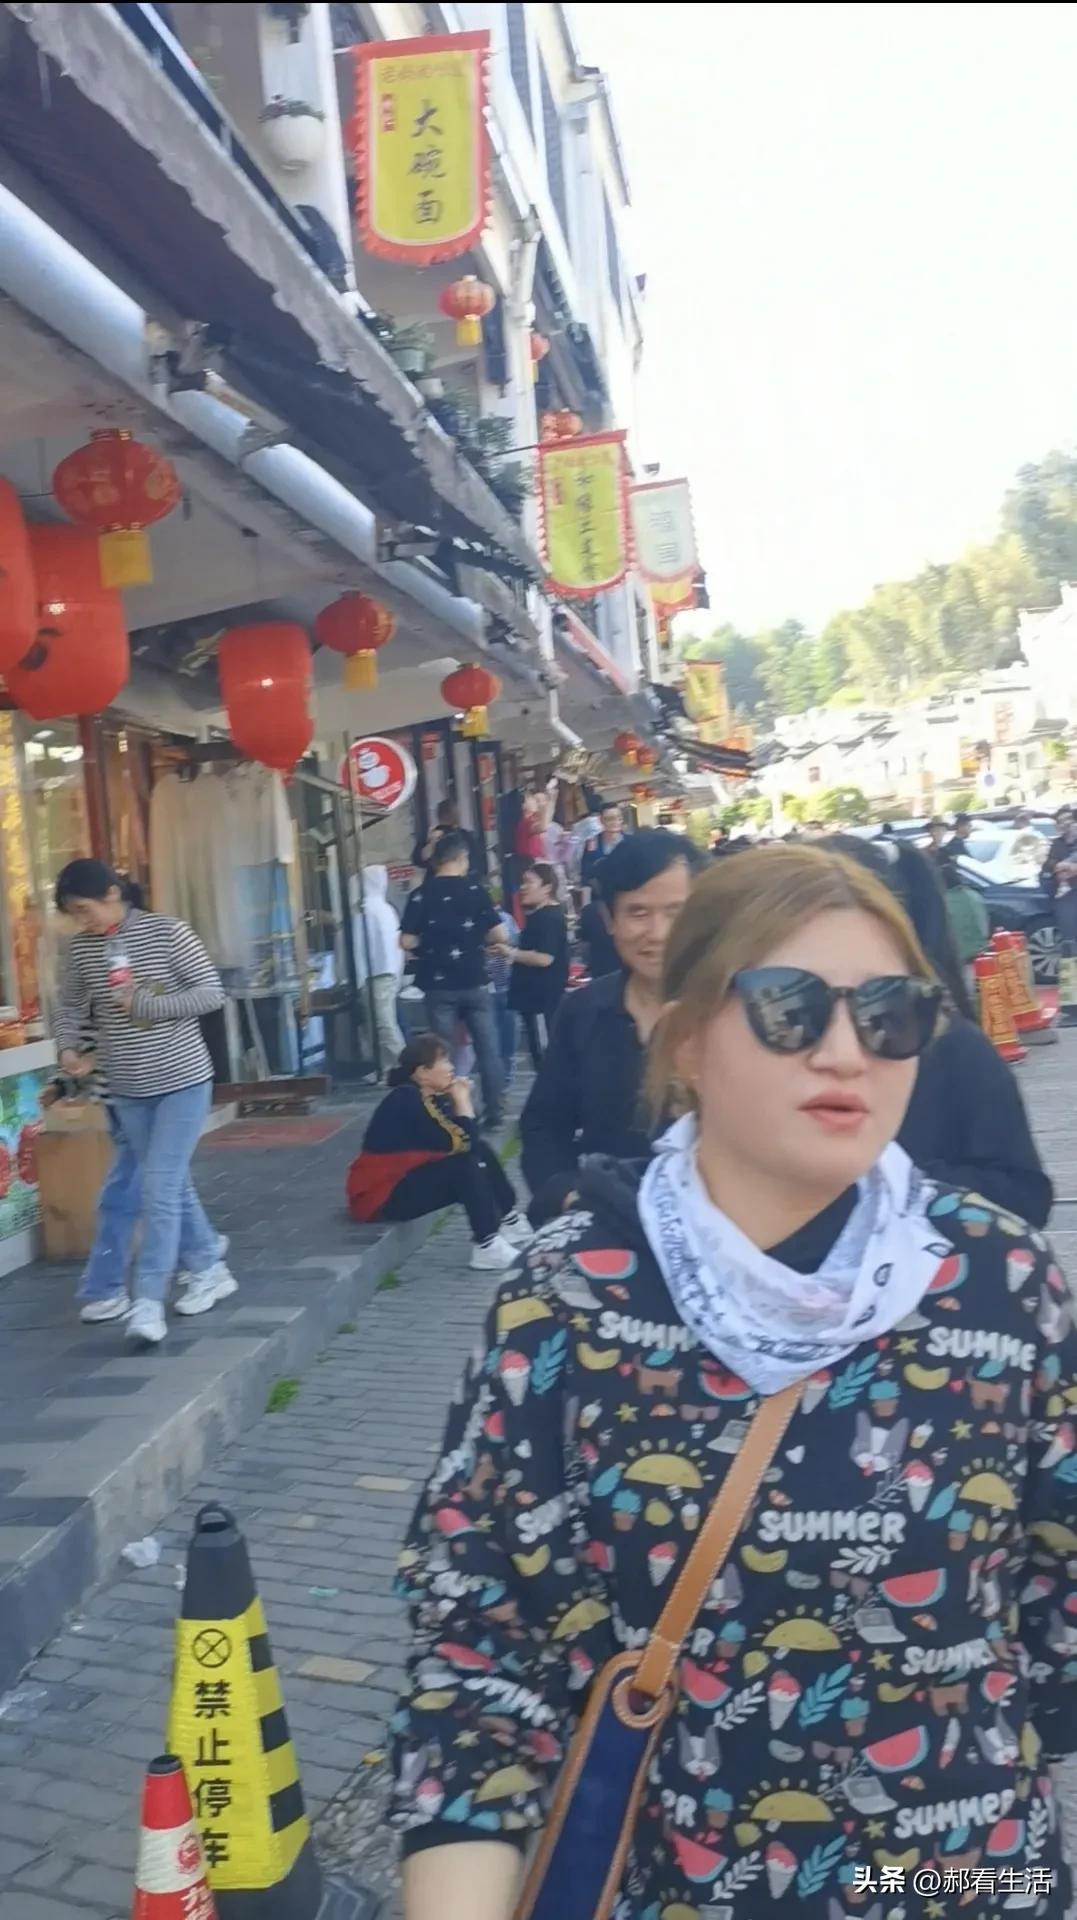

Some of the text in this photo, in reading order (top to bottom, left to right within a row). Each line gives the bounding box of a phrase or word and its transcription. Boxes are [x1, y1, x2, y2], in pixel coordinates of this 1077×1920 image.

[407, 98, 446, 225] 大碗面
[757, 1510, 907, 1544] SUMMER
[193, 1679, 233, 1869] 禁止停车
